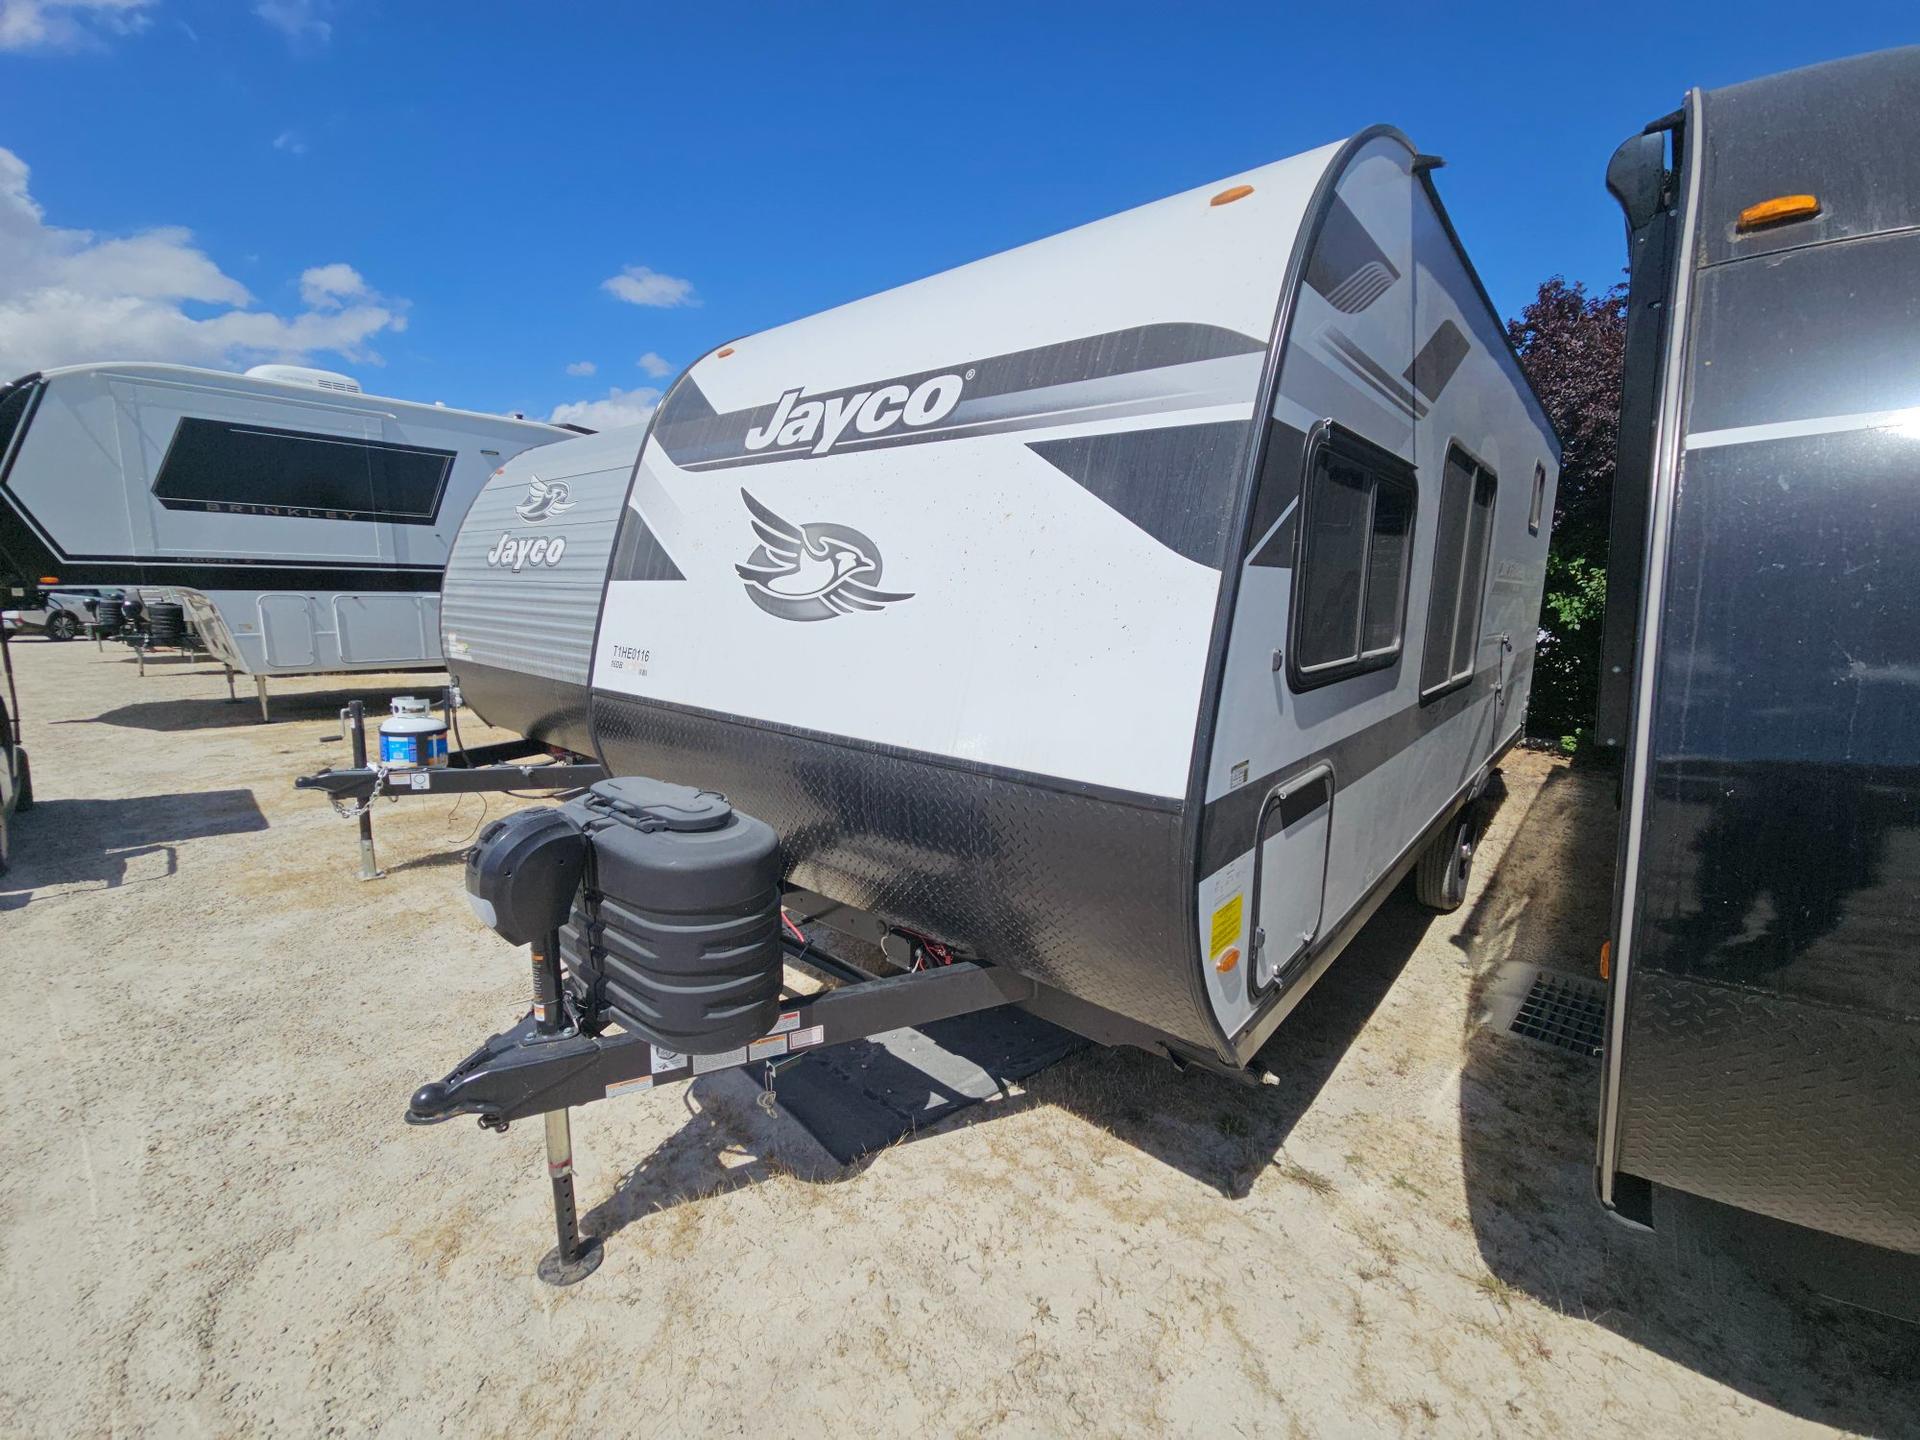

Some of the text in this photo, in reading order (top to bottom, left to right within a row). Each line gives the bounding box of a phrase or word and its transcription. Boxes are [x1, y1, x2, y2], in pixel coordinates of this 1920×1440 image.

[745, 374, 963, 454] Jayco
[206, 502, 356, 519] BRINKLEY
[487, 532, 566, 572] Jayco
[614, 645, 650, 662] T1HE0116
